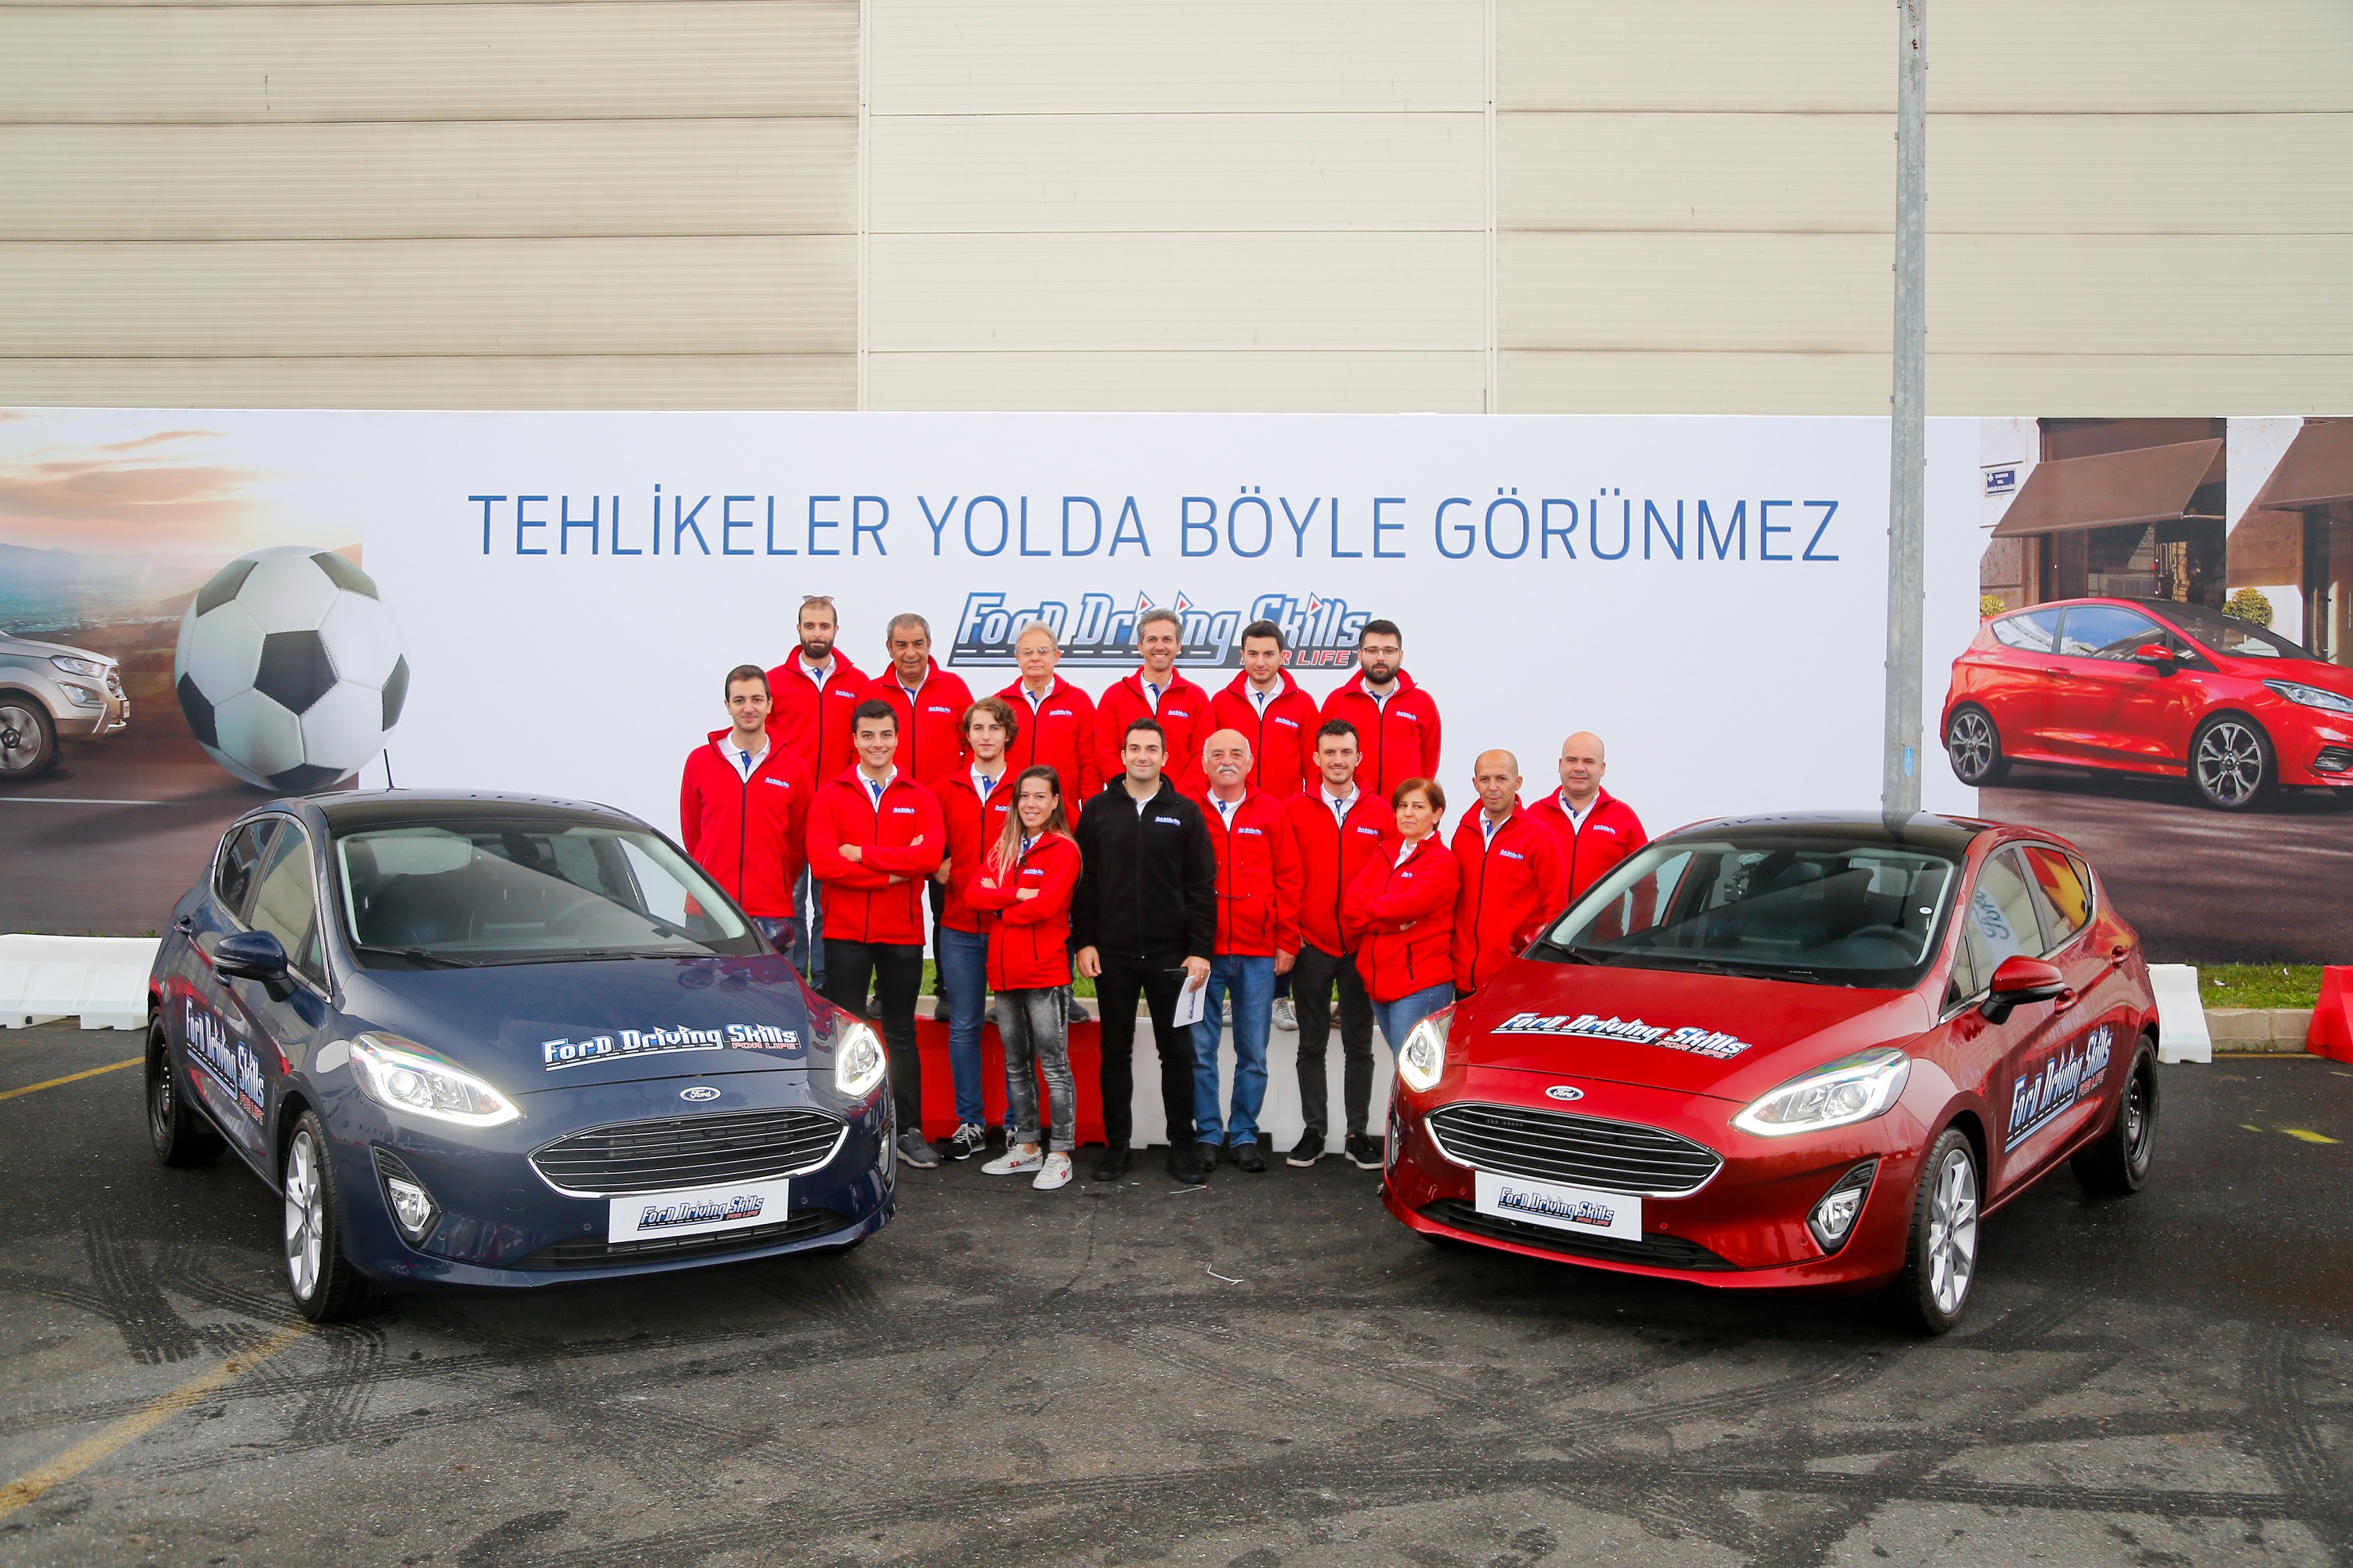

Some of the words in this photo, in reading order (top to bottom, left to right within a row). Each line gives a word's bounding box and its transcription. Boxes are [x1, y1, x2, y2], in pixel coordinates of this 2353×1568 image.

[468, 483, 890, 556] TEHLİKELER
[918, 495, 1152, 557] YOLDA
[1180, 486, 1407, 558] BÖYLE
[1435, 487, 1840, 561] GÖRÜNMEZ
[1296, 650, 1350, 666] LIFE
[617, 1025, 724, 1050] Driving
[726, 1023, 800, 1044] Skills
[1564, 1014, 1671, 1043] Driving
[1663, 1026, 1752, 1056] Skills
[1655, 1038, 1691, 1051] FOR
[1689, 1047, 1729, 1059] LIFE
[205, 1011, 238, 1101] Driving
[237, 1041, 265, 1109] Skills
[2039, 1042, 2086, 1112] Driving
[2081, 1023, 2113, 1081] Skills
[677, 1199, 727, 1222] Driving
[728, 1195, 765, 1213] Skills
[1530, 1193, 1576, 1221] Driving
[1577, 1201, 1615, 1221] Skills
